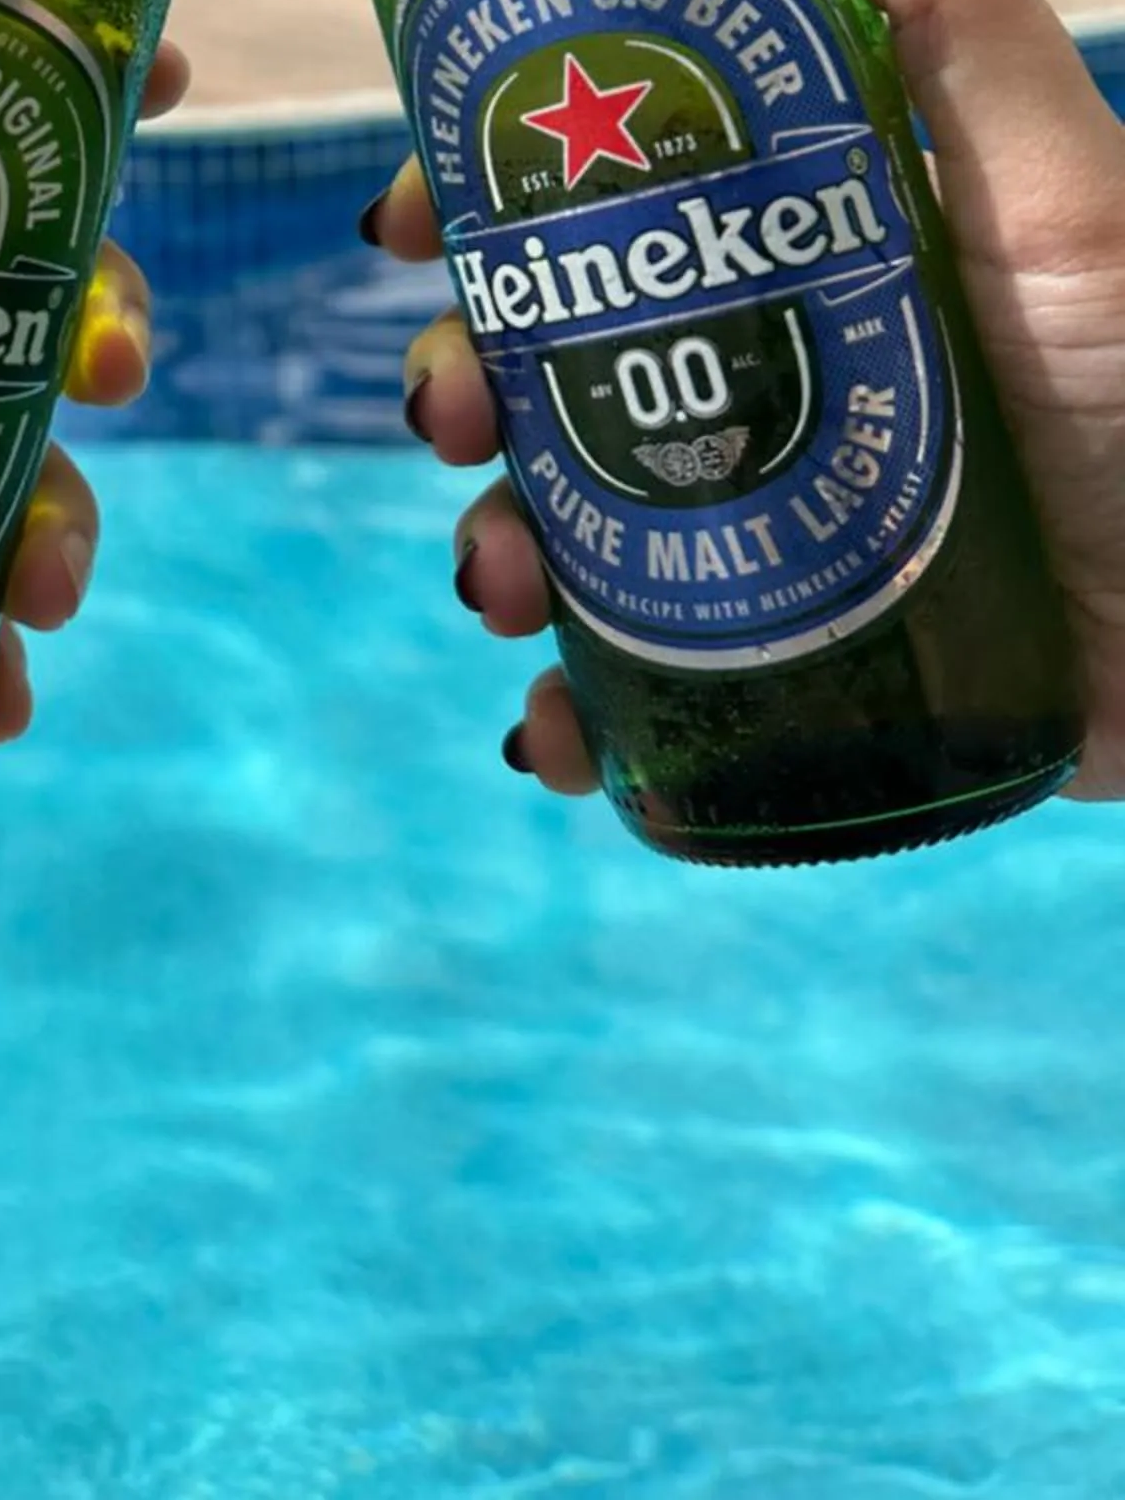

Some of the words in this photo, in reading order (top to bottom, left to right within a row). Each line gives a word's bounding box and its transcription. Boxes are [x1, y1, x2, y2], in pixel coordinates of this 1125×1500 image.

[521, 170, 557, 194] EST.
[455, 177, 887, 335] Heineken
[613, 336, 732, 430] 0.0
[529, 449, 626, 568] PURE
[646, 514, 781, 584] MALT
[790, 382, 896, 543] LAGER
[616, 589, 684, 621] RECIPE
[692, 598, 751, 621] WITH
[759, 550, 864, 612] HEINEKEN
